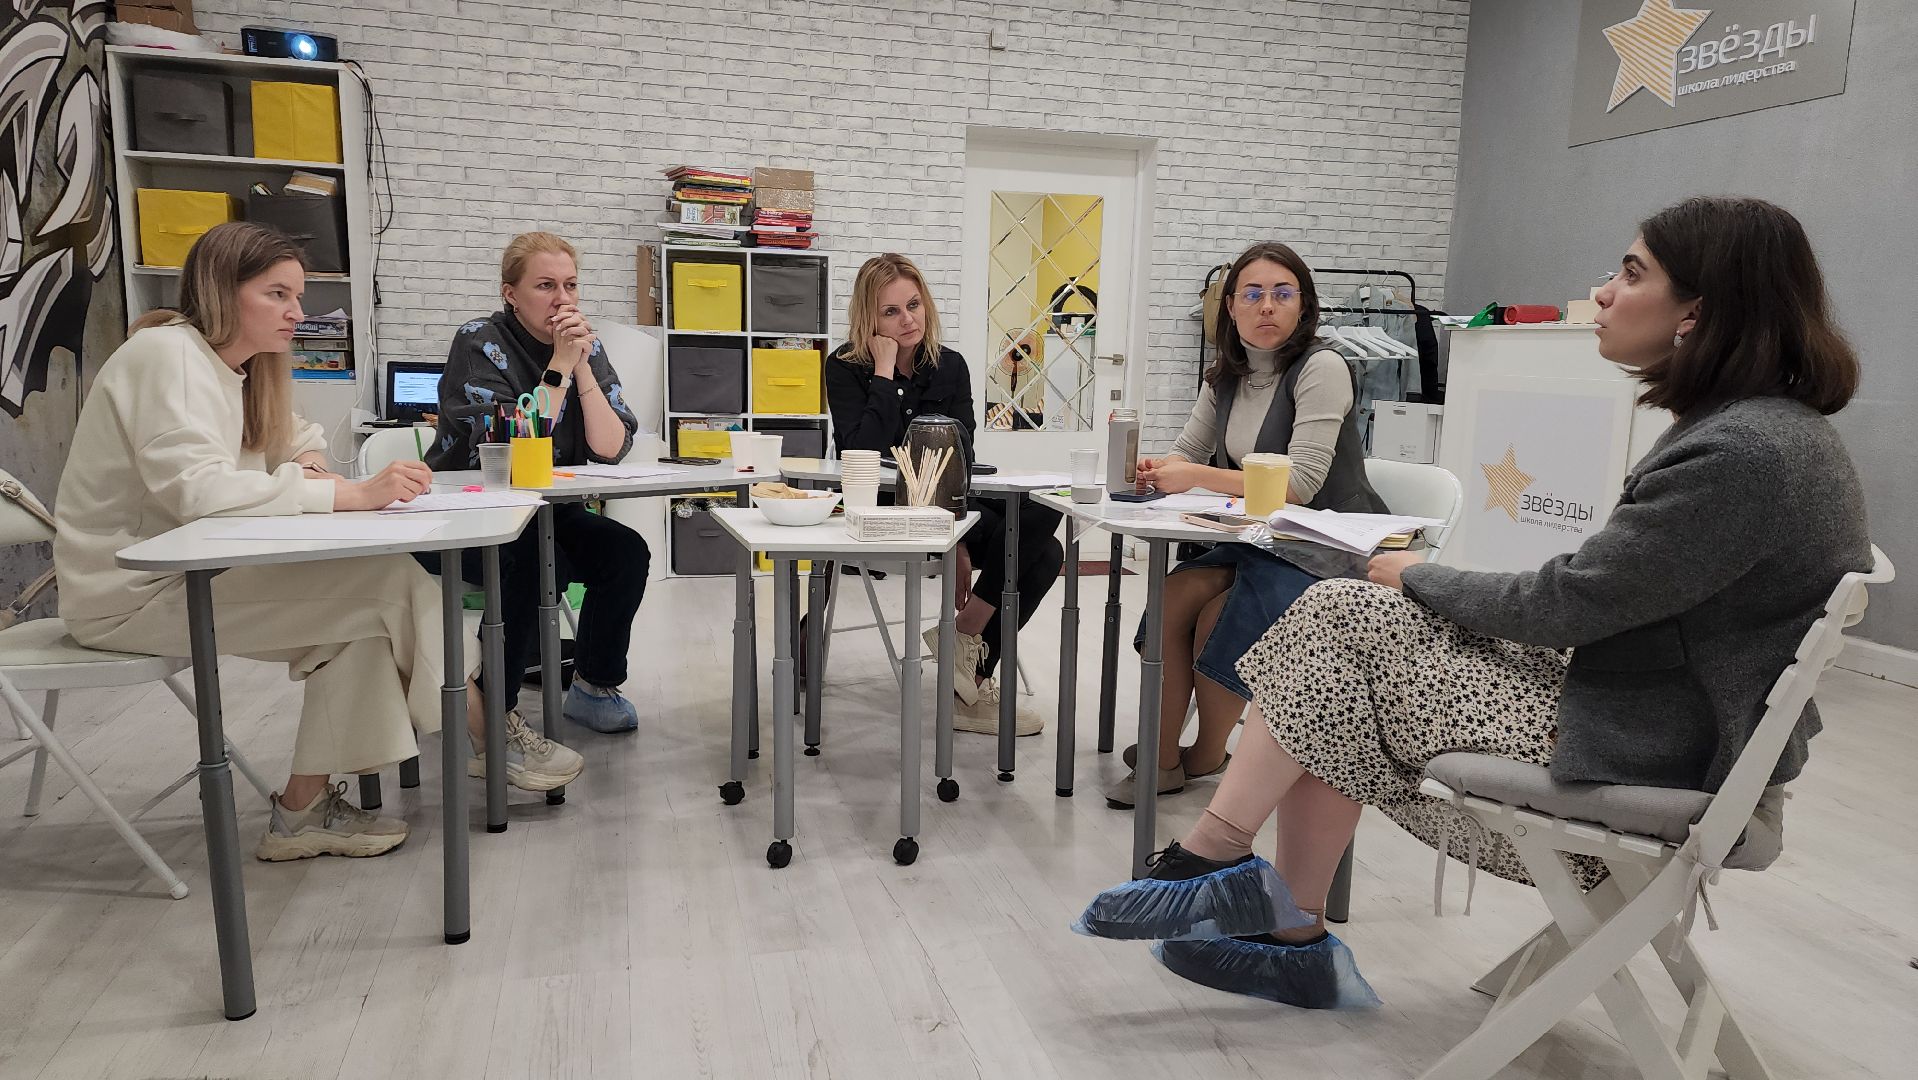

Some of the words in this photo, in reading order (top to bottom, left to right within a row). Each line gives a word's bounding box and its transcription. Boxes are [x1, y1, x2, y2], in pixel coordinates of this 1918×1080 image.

[1677, 77, 1720, 96] школа
[1720, 60, 1796, 84] лидерства
[1520, 516, 1543, 526] школа
